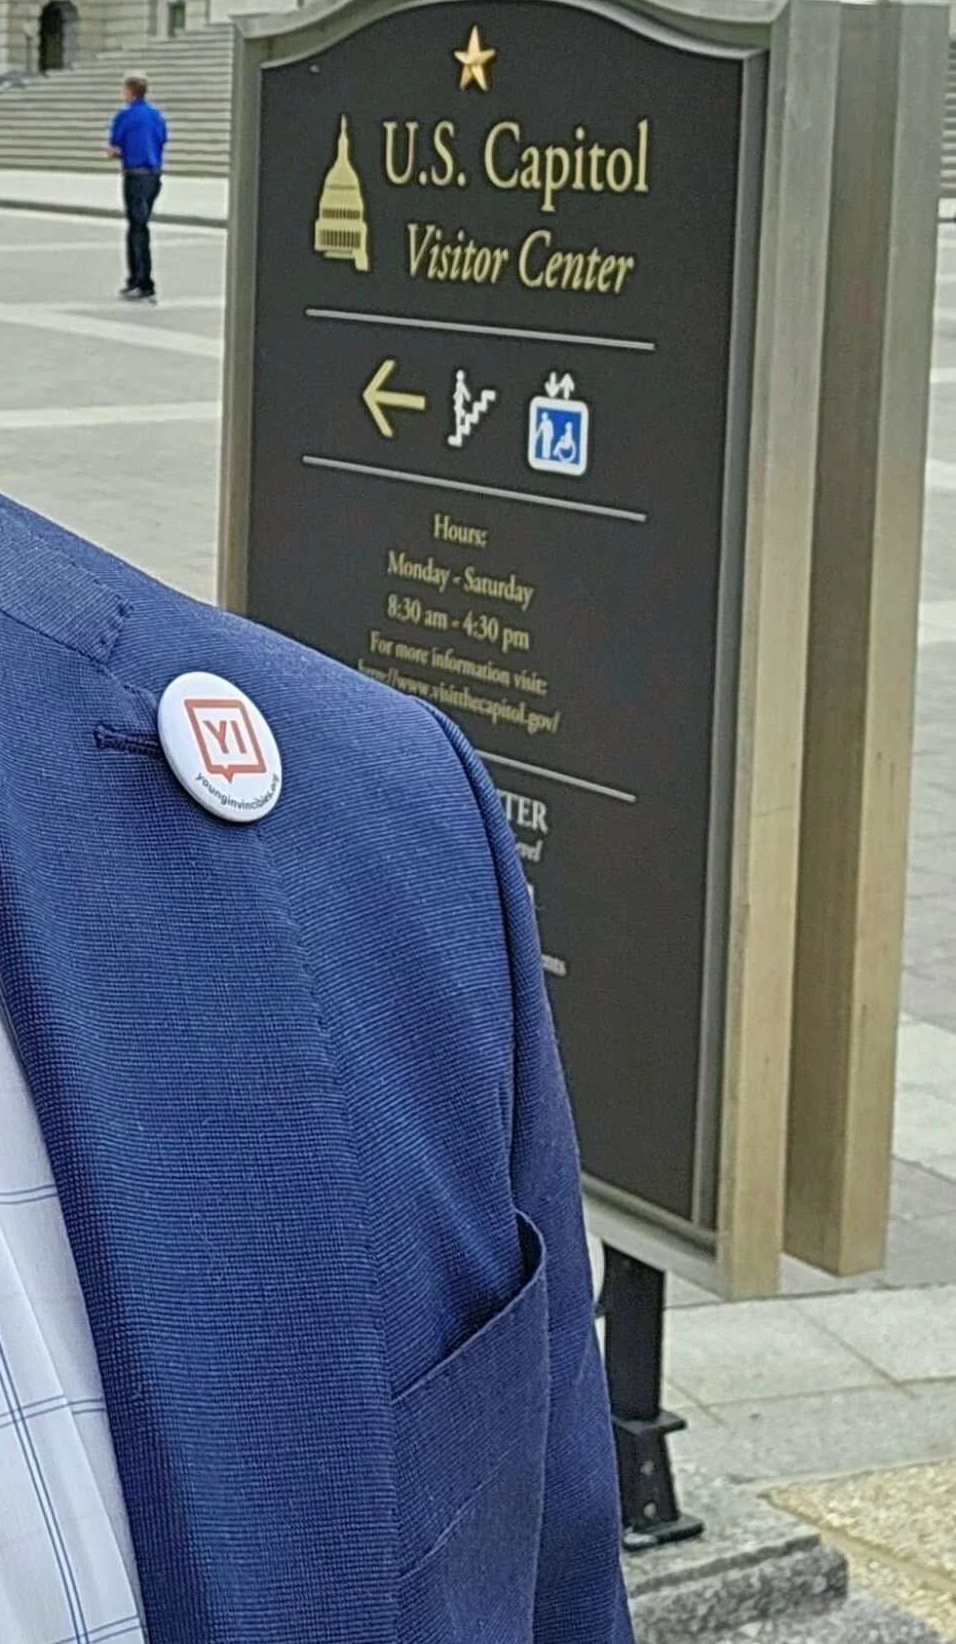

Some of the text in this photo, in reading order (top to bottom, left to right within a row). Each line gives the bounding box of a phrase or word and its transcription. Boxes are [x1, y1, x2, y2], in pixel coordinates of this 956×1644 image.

[382, 118, 650, 212] U.S. Capitol
[406, 223, 635, 293] Visitor Center
[433, 513, 488, 548] Hours:
[387, 550, 451, 593] Monday
[464, 566, 534, 612] Saturday
[387, 594, 421, 624] 8:30
[424, 609, 448, 630] am
[462, 610, 499, 642] 4:30
[502, 627, 530, 654] pm
[370, 630, 393, 656] For
[395, 643, 429, 666] more
[431, 647, 510, 687] information
[203, 720, 247, 755] YI
